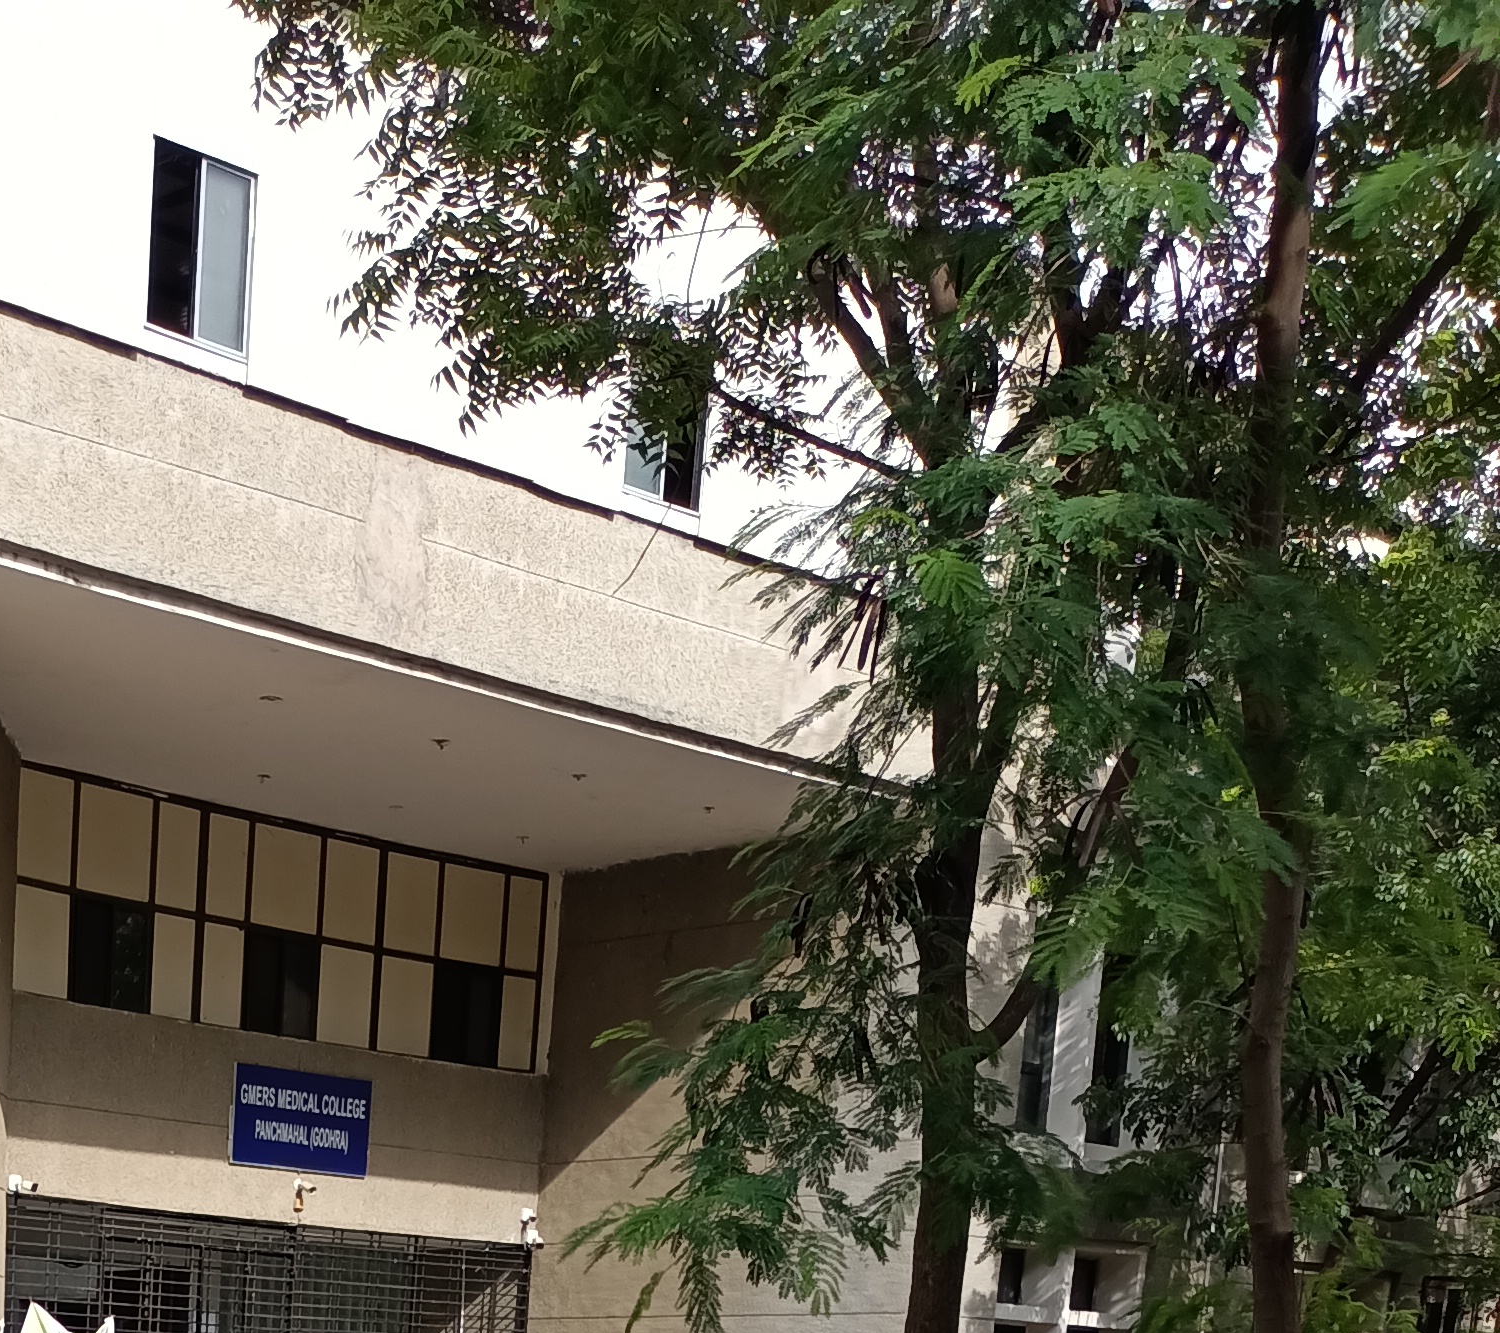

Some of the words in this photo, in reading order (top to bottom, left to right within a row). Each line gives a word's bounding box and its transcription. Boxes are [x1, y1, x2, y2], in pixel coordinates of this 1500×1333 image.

[240, 1083, 276, 1108] GMERS
[277, 1088, 320, 1114] MEDICAL
[321, 1094, 367, 1120] COLLEGE
[254, 1119, 308, 1146] PANCHMAHAL
[309, 1126, 349, 1155] (GODHRA)
